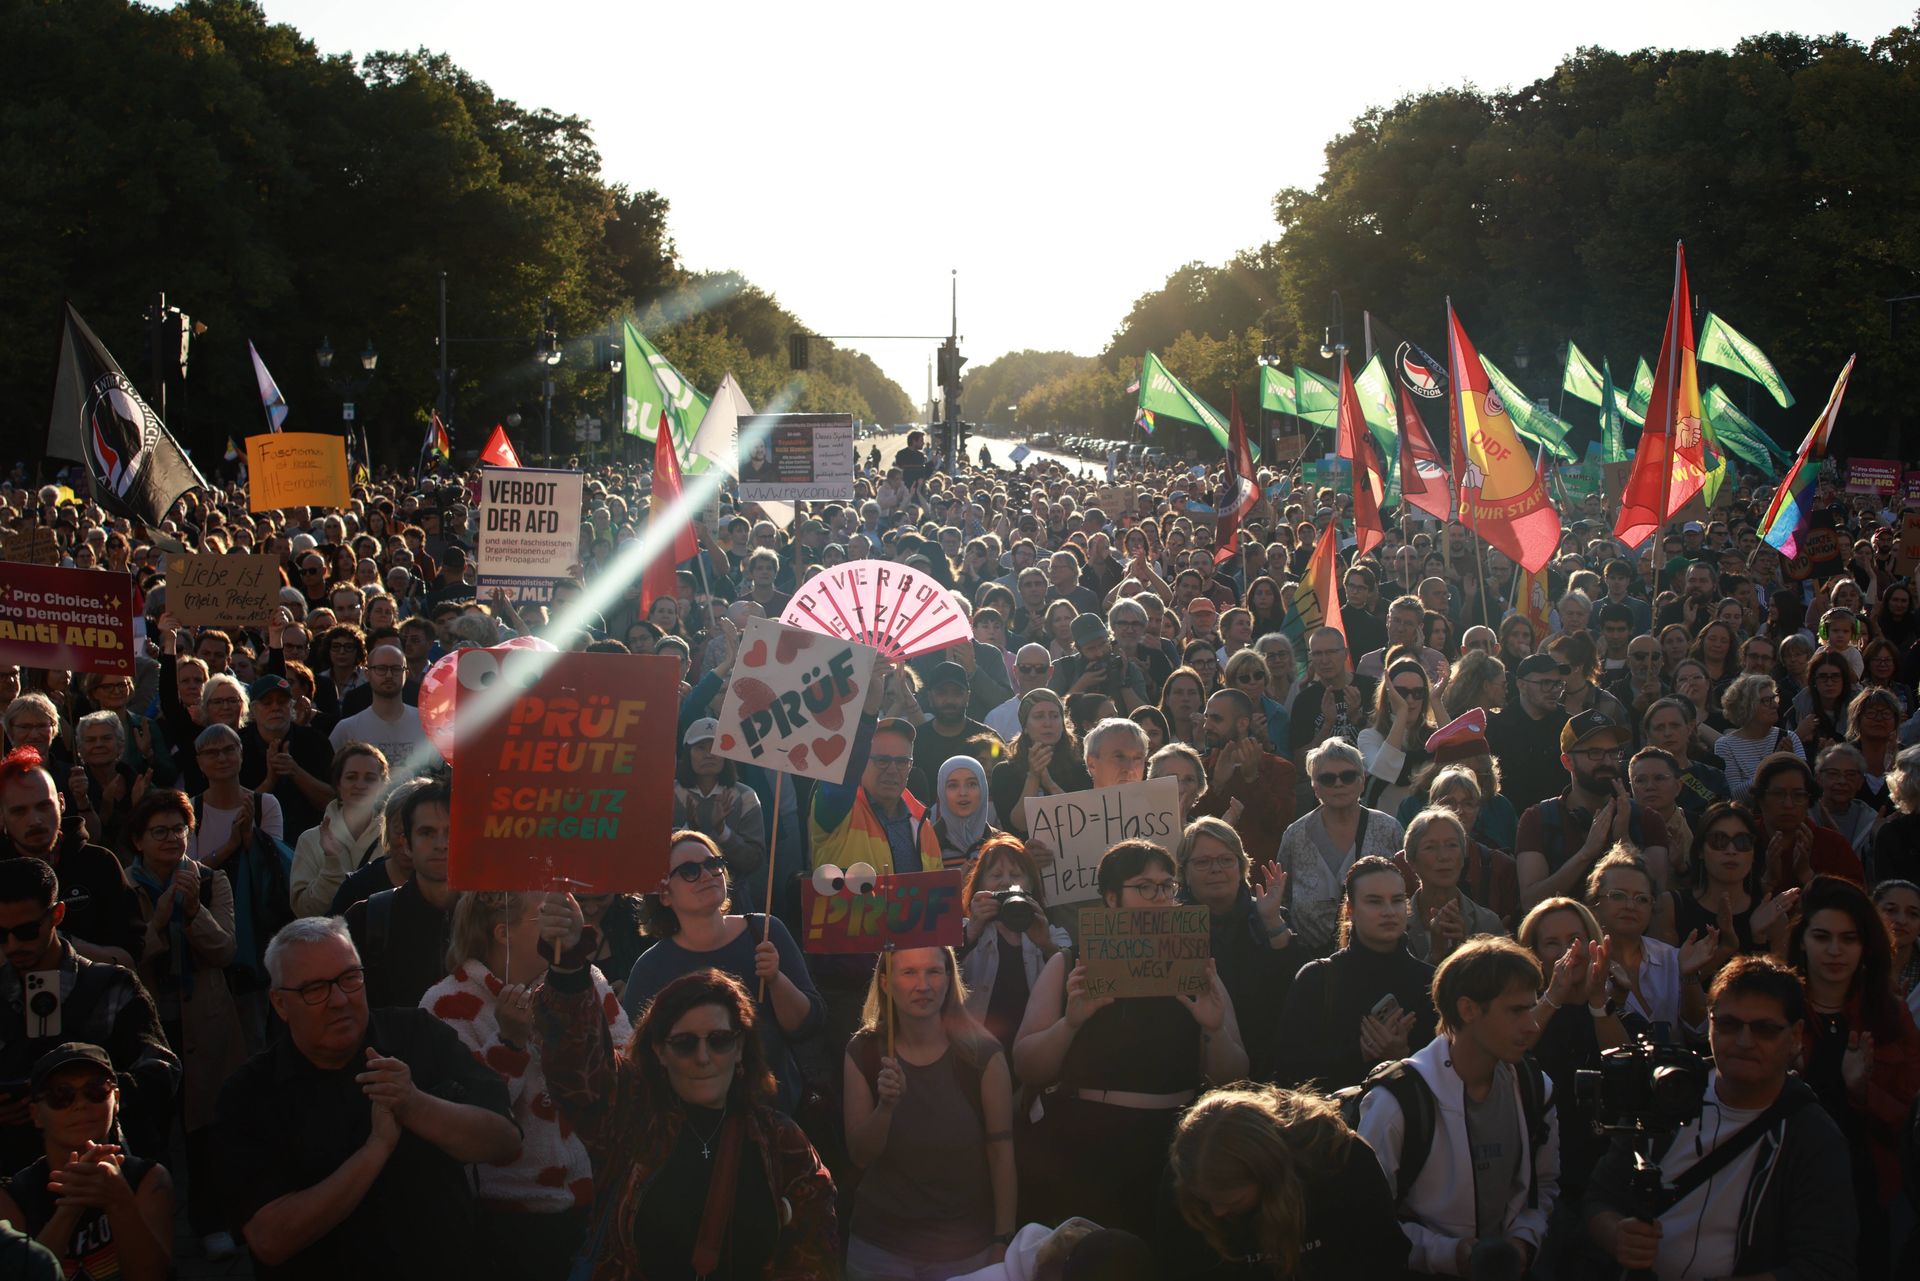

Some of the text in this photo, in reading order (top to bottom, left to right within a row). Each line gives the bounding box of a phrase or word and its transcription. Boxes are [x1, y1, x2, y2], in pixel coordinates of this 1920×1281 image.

[1413, 385, 1441, 396] ACTION
[1470, 430, 1512, 463] DIDF
[489, 480, 557, 505] VERBOT
[487, 508, 559, 533] DER AFD
[1474, 507, 1504, 520] WIR
[485, 547, 541, 556] Organisationen
[520, 539, 572, 548] faschistischen
[485, 555, 502, 563] ihrer
[181, 559, 264, 588] Liebe ist
[13, 589, 104, 609] Pro Choice.
[226, 589, 270, 609] Protest.
[26, 607, 123, 627] Demokratie.
[829, 604, 912, 635] ETZT
[0, 619, 125, 650] Anti AfD.
[740, 647, 854, 759] PRÜF
[507, 695, 647, 738] PRÜF
[499, 740, 638, 774] HEUTE
[491, 786, 628, 814] SCHÜTZ
[483, 815, 620, 841] MORGEN
[1086, 938, 1155, 960] FASCHOS
[1126, 960, 1174, 978] WEG!
[1086, 975, 1209, 999] HEX HEX
